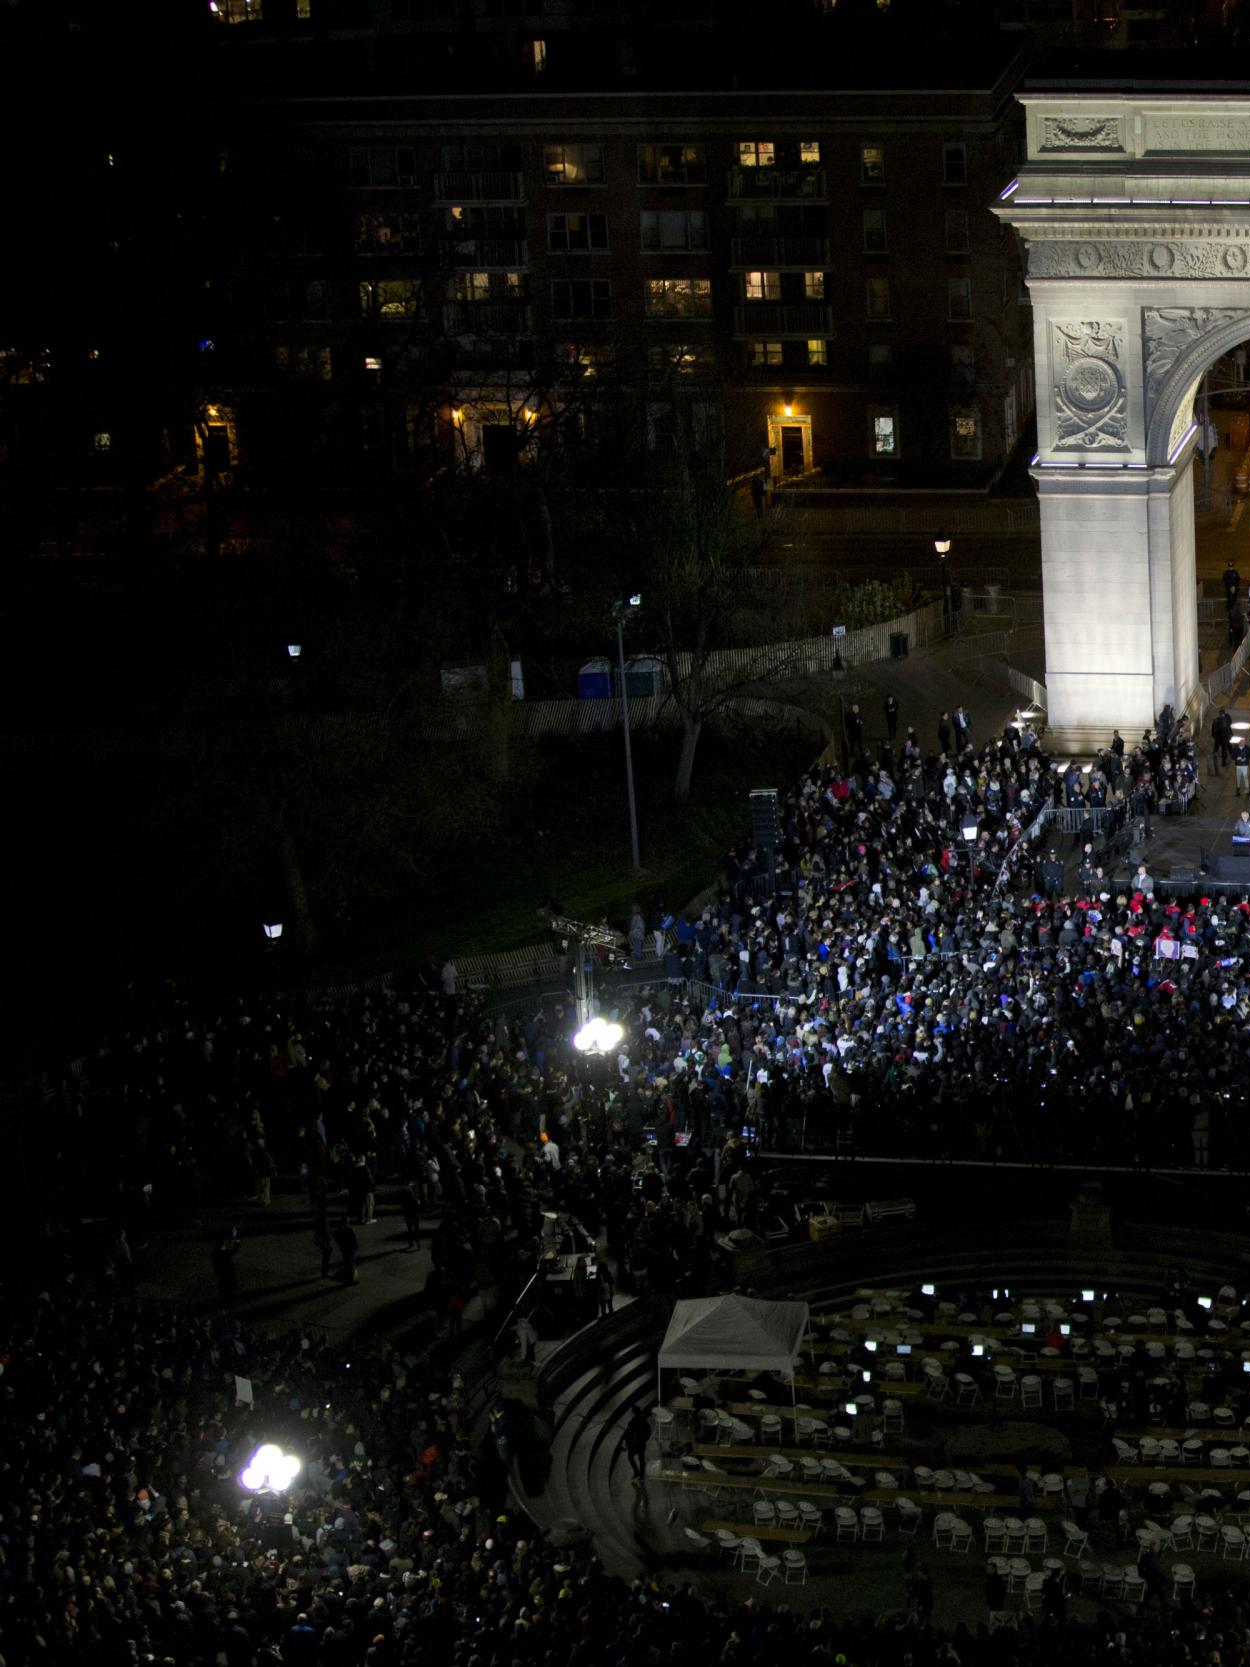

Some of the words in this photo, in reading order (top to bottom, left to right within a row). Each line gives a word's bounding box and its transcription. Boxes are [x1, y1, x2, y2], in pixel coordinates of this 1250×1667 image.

[1152, 118, 1178, 129] LET
[1181, 118, 1195, 129] US
[1198, 118, 1233, 129] RAISE
[1154, 129, 1179, 139] AND
[1186, 129, 1209, 139] THE
[1187, 140, 1210, 150] THE
